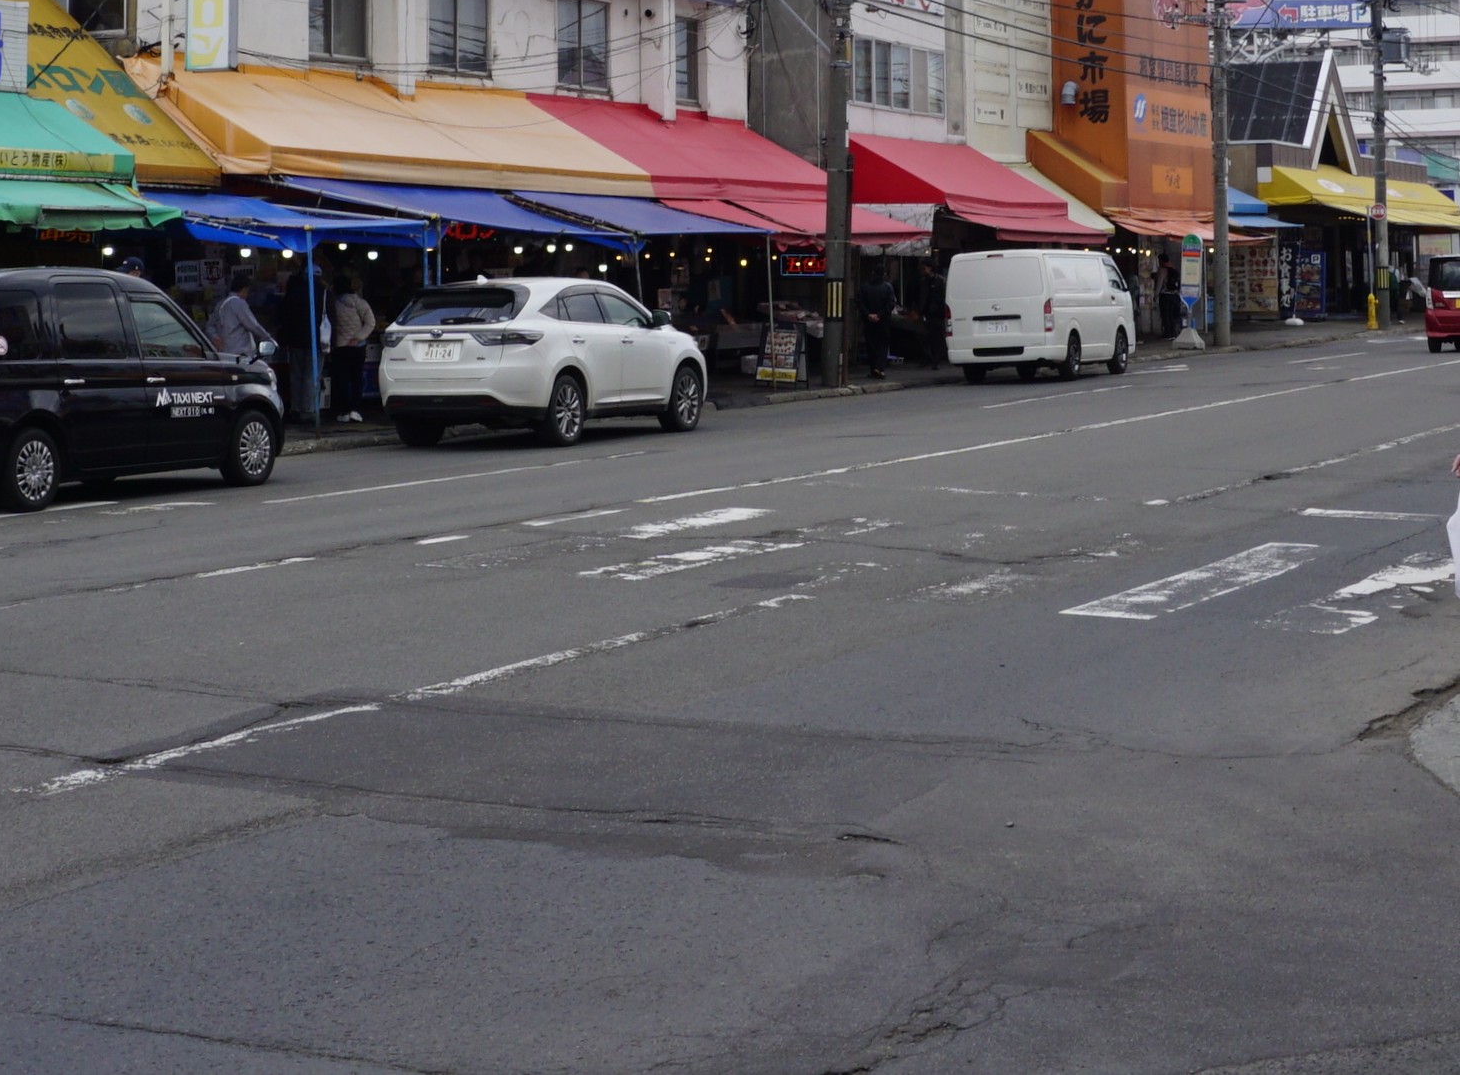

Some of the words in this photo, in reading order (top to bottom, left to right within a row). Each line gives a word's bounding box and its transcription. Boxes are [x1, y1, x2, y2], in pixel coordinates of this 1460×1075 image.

[1300, 5, 1349, 22] 駐車場
[191, 391, 213, 404] NEXT
